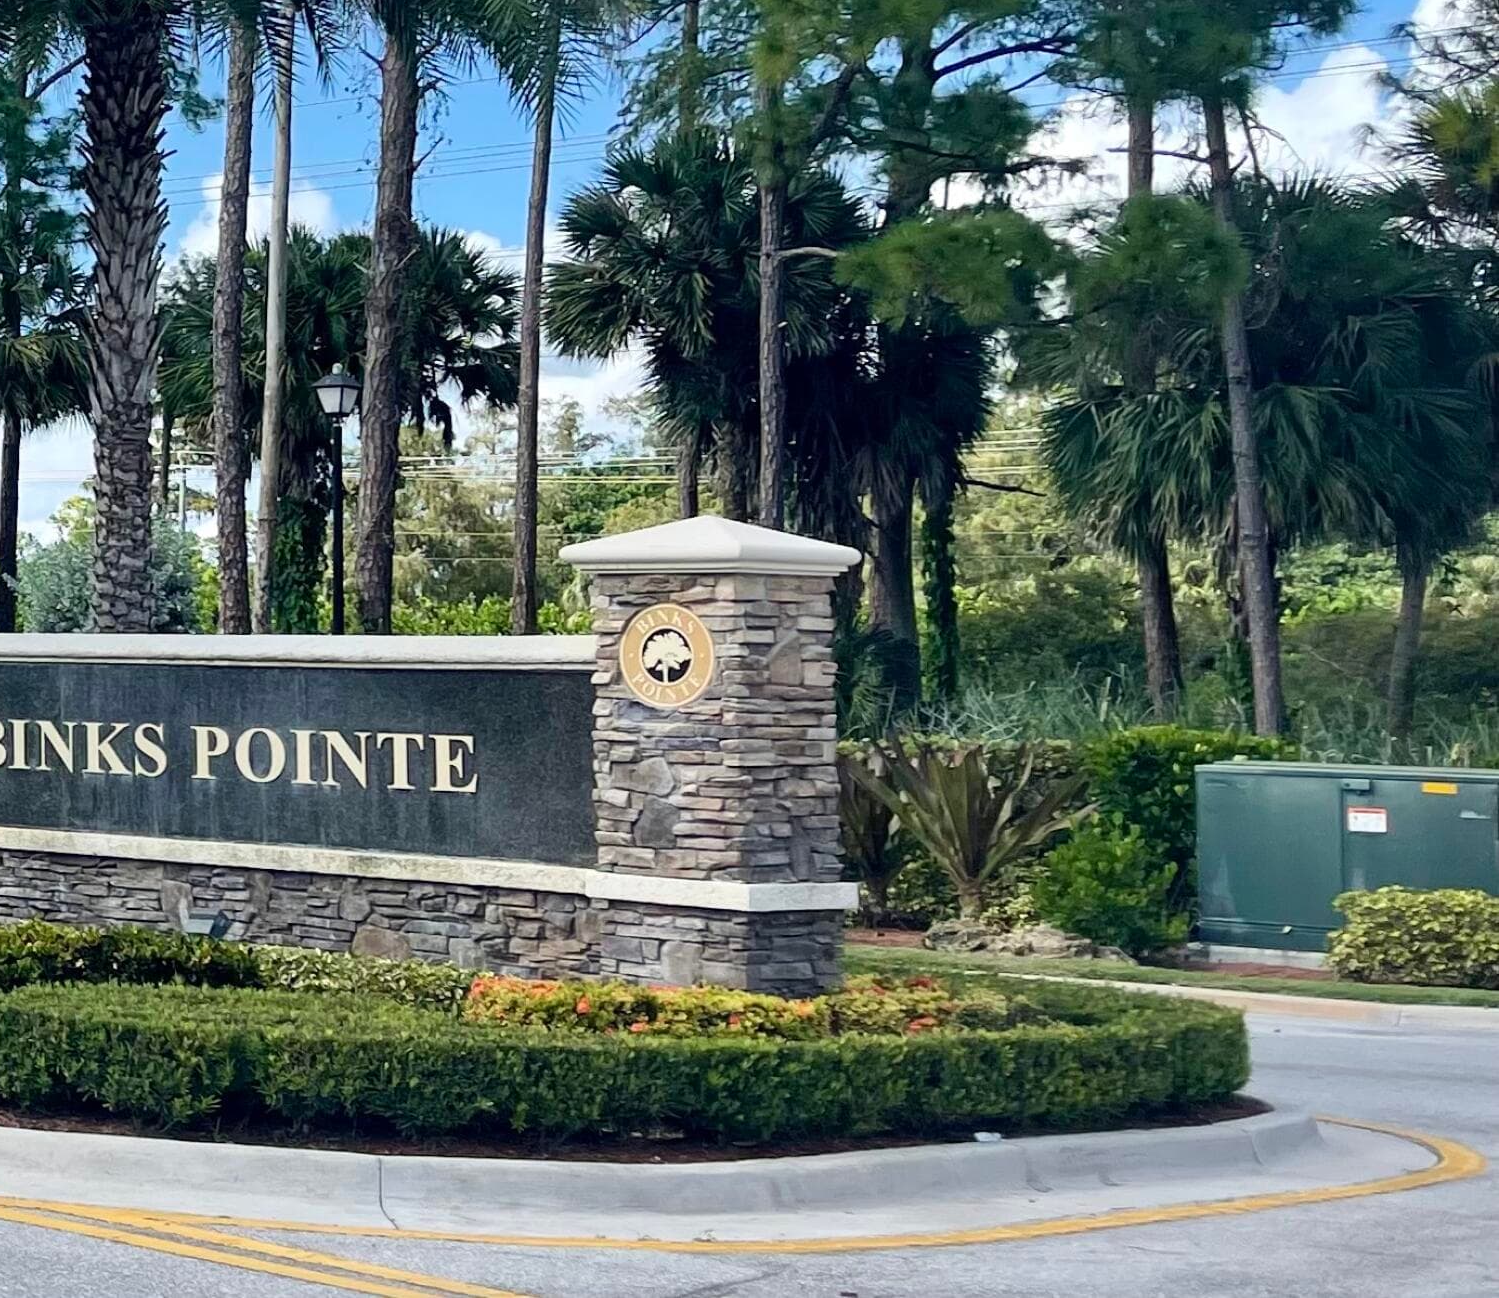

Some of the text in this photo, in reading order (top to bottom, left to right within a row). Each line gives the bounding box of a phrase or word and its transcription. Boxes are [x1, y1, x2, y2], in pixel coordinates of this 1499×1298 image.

[636, 610, 696, 634] BINKS
[631, 674, 702, 700] POINTE
[190, 725, 478, 793] POINTE
